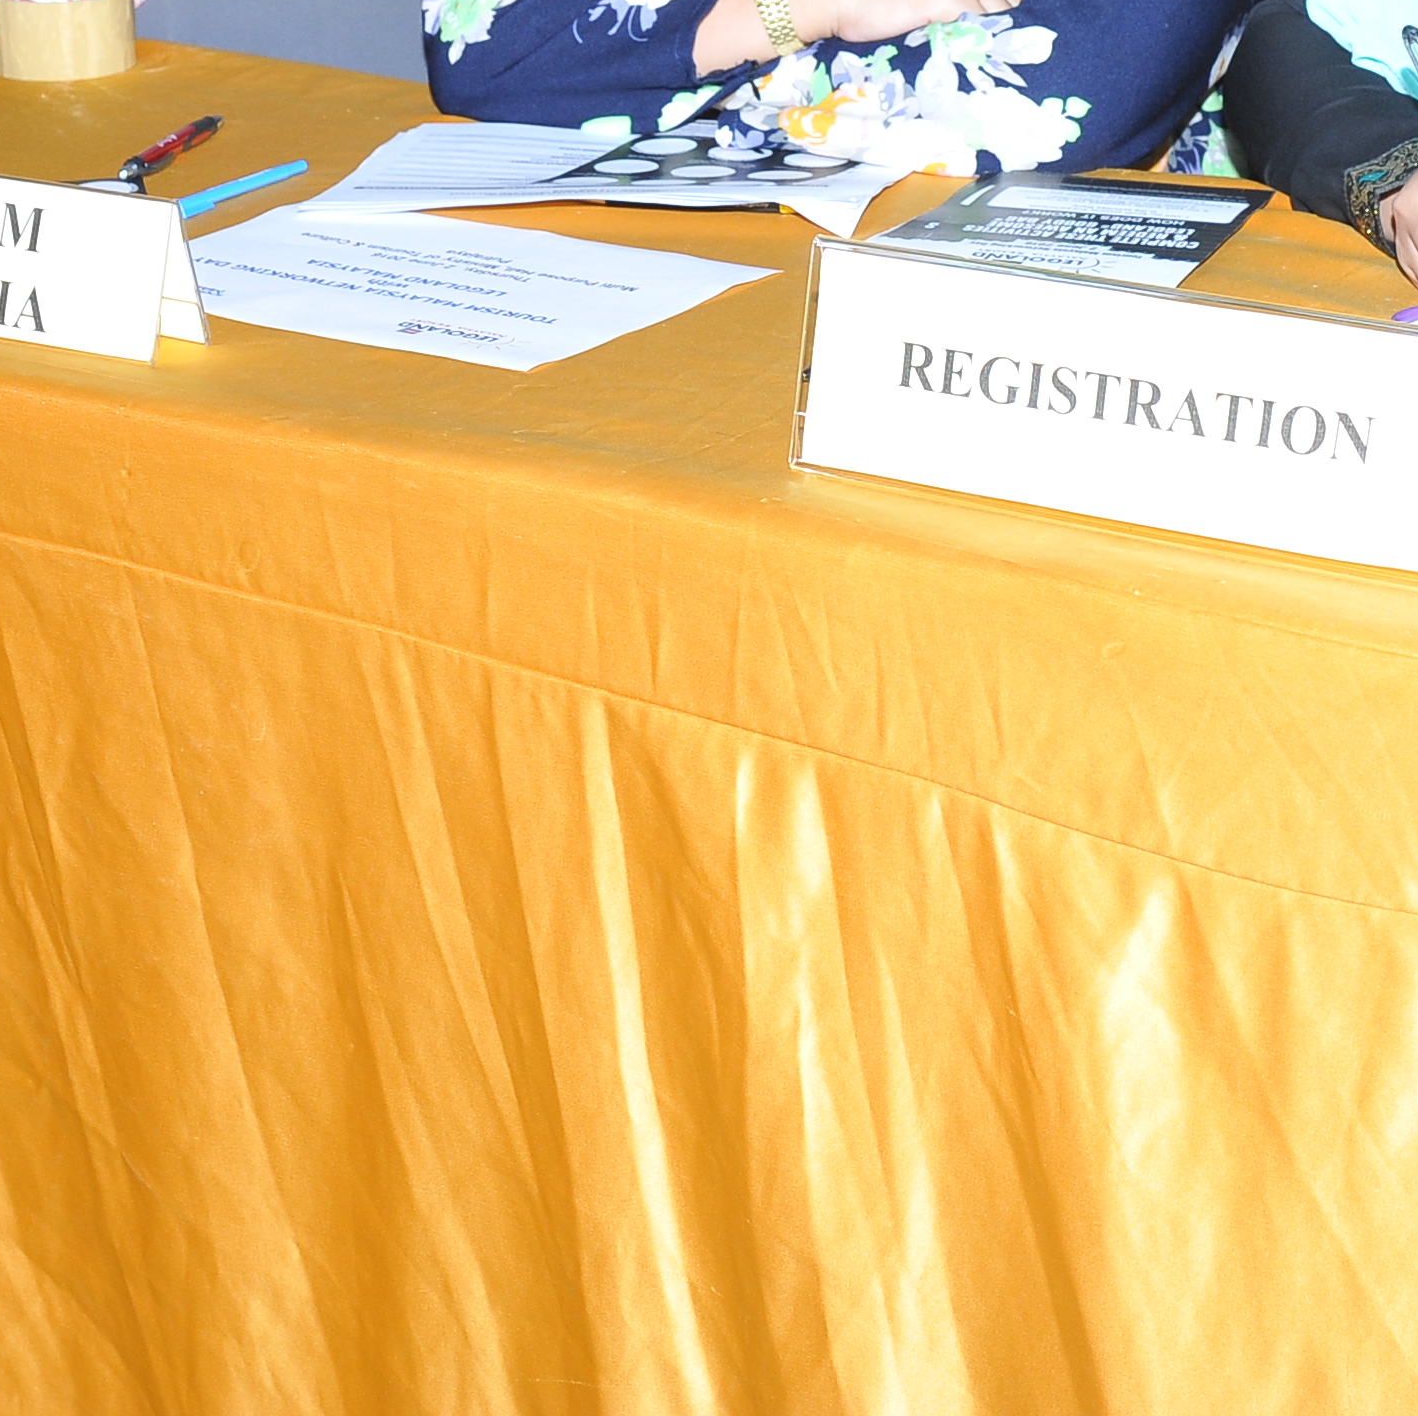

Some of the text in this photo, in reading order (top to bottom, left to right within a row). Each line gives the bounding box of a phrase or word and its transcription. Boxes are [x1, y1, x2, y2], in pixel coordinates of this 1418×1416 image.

[300, 232, 352, 245] Culture
[962, 224, 1200, 249] COMPLETE THESE ACTIVITIES
[1099, 228, 1169, 240] REDEEM
[366, 244, 422, 258] Tourism
[369, 252, 408, 262] 2016
[445, 249, 513, 265] Putrajaya
[408, 259, 444, 267] June
[441, 256, 501, 270] Ministry
[972, 252, 1084, 265] LEGOLAND
[306, 259, 508, 296] LEGOLAND MALAYSIA
[367, 279, 409, 288] with
[537, 273, 599, 286] Purpose
[193, 257, 558, 324] TOURISM MALAYSIA NETWORKING DAY
[599, 283, 639, 292] Multi
[397, 321, 499, 343] LEGOLAND
[898, 341, 1375, 464] REGISTRATION
